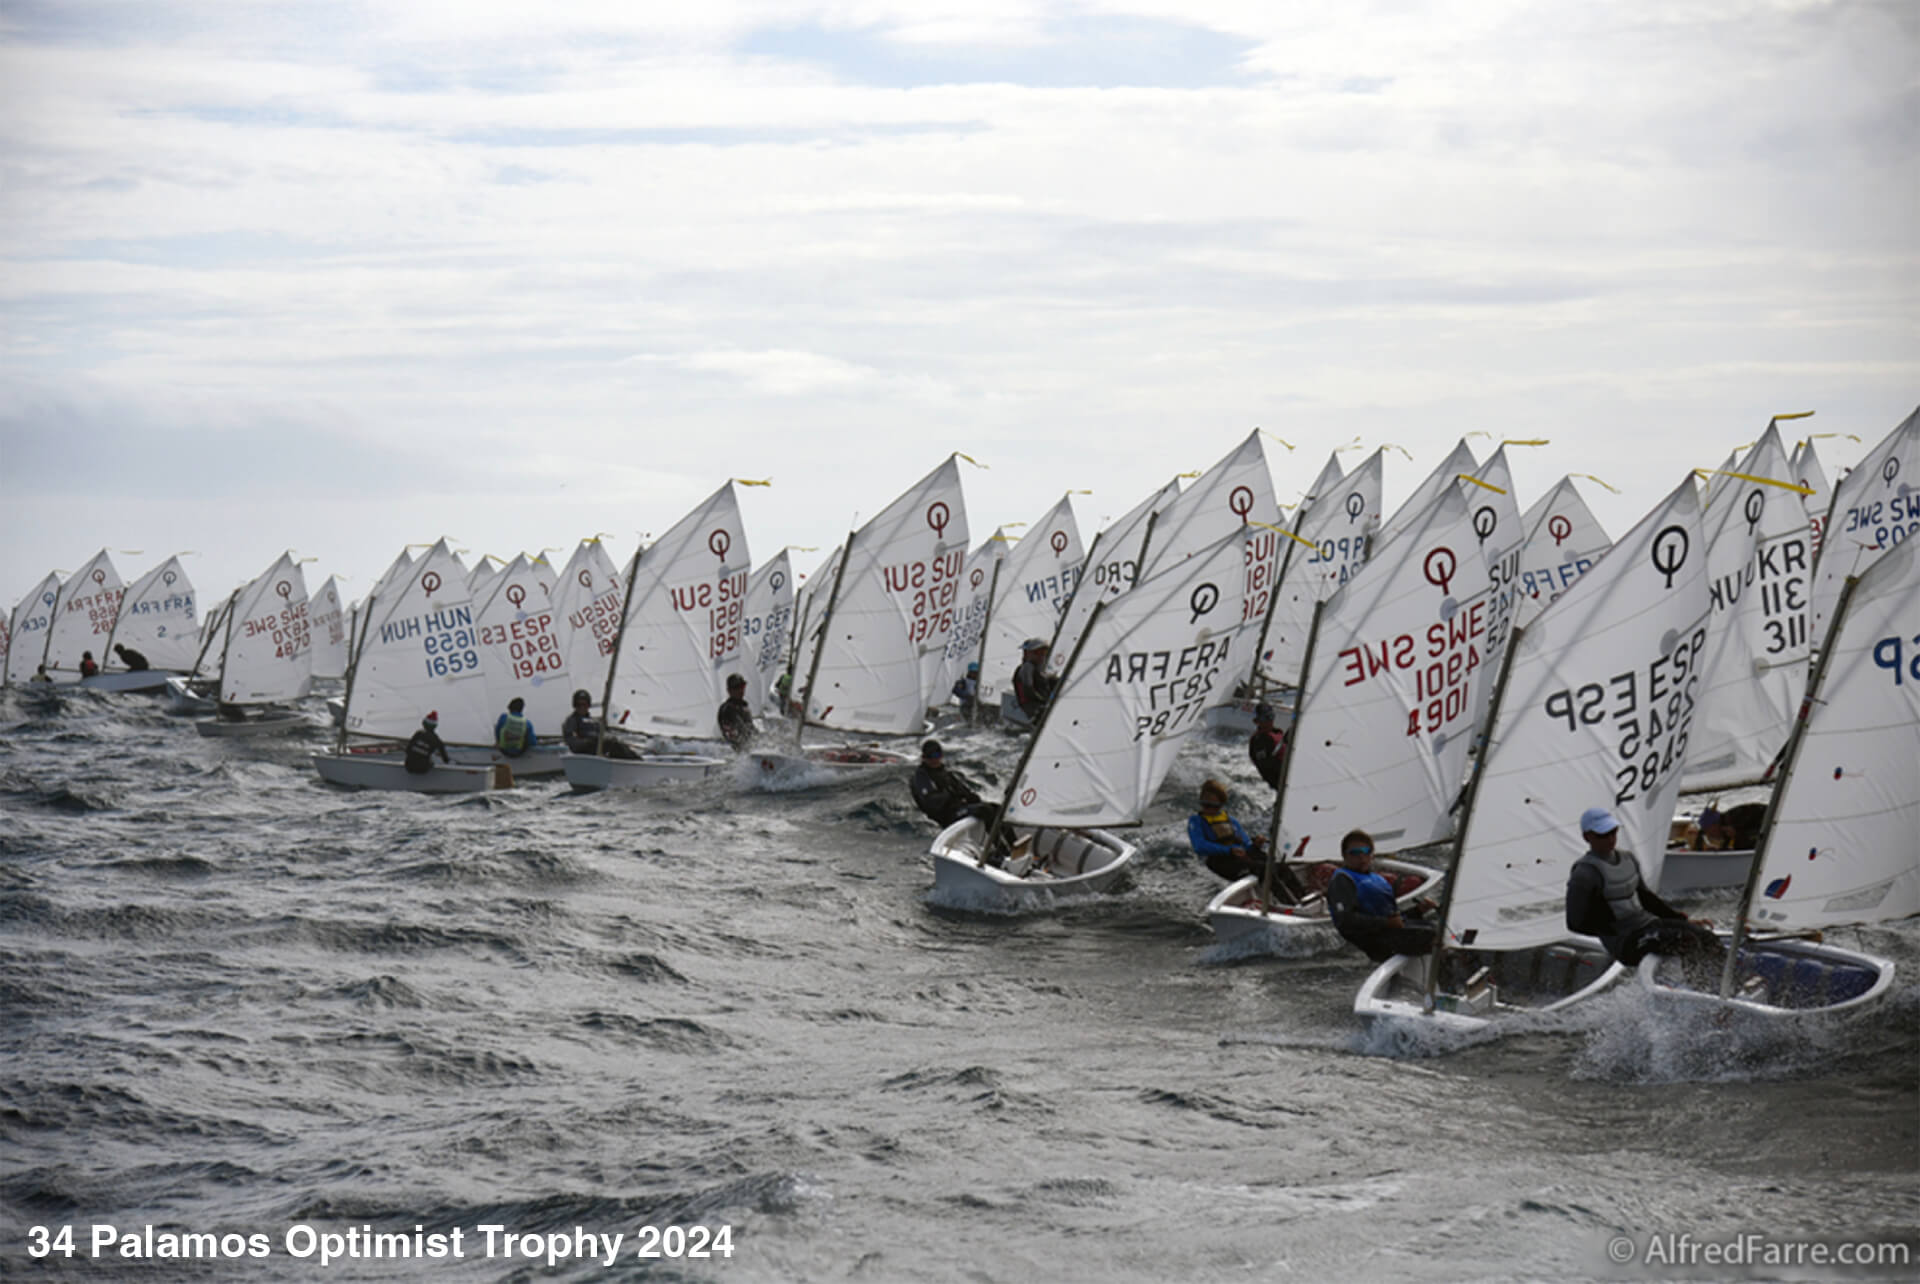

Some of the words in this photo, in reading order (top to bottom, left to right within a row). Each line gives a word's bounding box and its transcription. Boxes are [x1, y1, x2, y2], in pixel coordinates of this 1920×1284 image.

[932, 551, 964, 582] SUI
[1245, 533, 1275, 567] SUI
[718, 571, 747, 602] SUI
[1488, 550, 1519, 594] SUI
[164, 595, 192, 611] FRA
[281, 602, 309, 626] SWE
[424, 605, 472, 633] HUN
[157, 625, 167, 638] 2
[510, 614, 552, 640] ESP
[709, 625, 740, 659] 1951
[909, 608, 953, 644] 1976
[1426, 600, 1486, 658] SWE
[1764, 613, 1805, 654] 311
[275, 632, 311, 658] 4870
[1176, 636, 1230, 676] FRA
[425, 650, 478, 678] 1659
[512, 652, 562, 680] 1940
[1650, 628, 1705, 703] ESP
[1133, 695, 1206, 742] 2877
[1407, 681, 1468, 738] 4901
[1615, 716, 1692, 807] 2845
